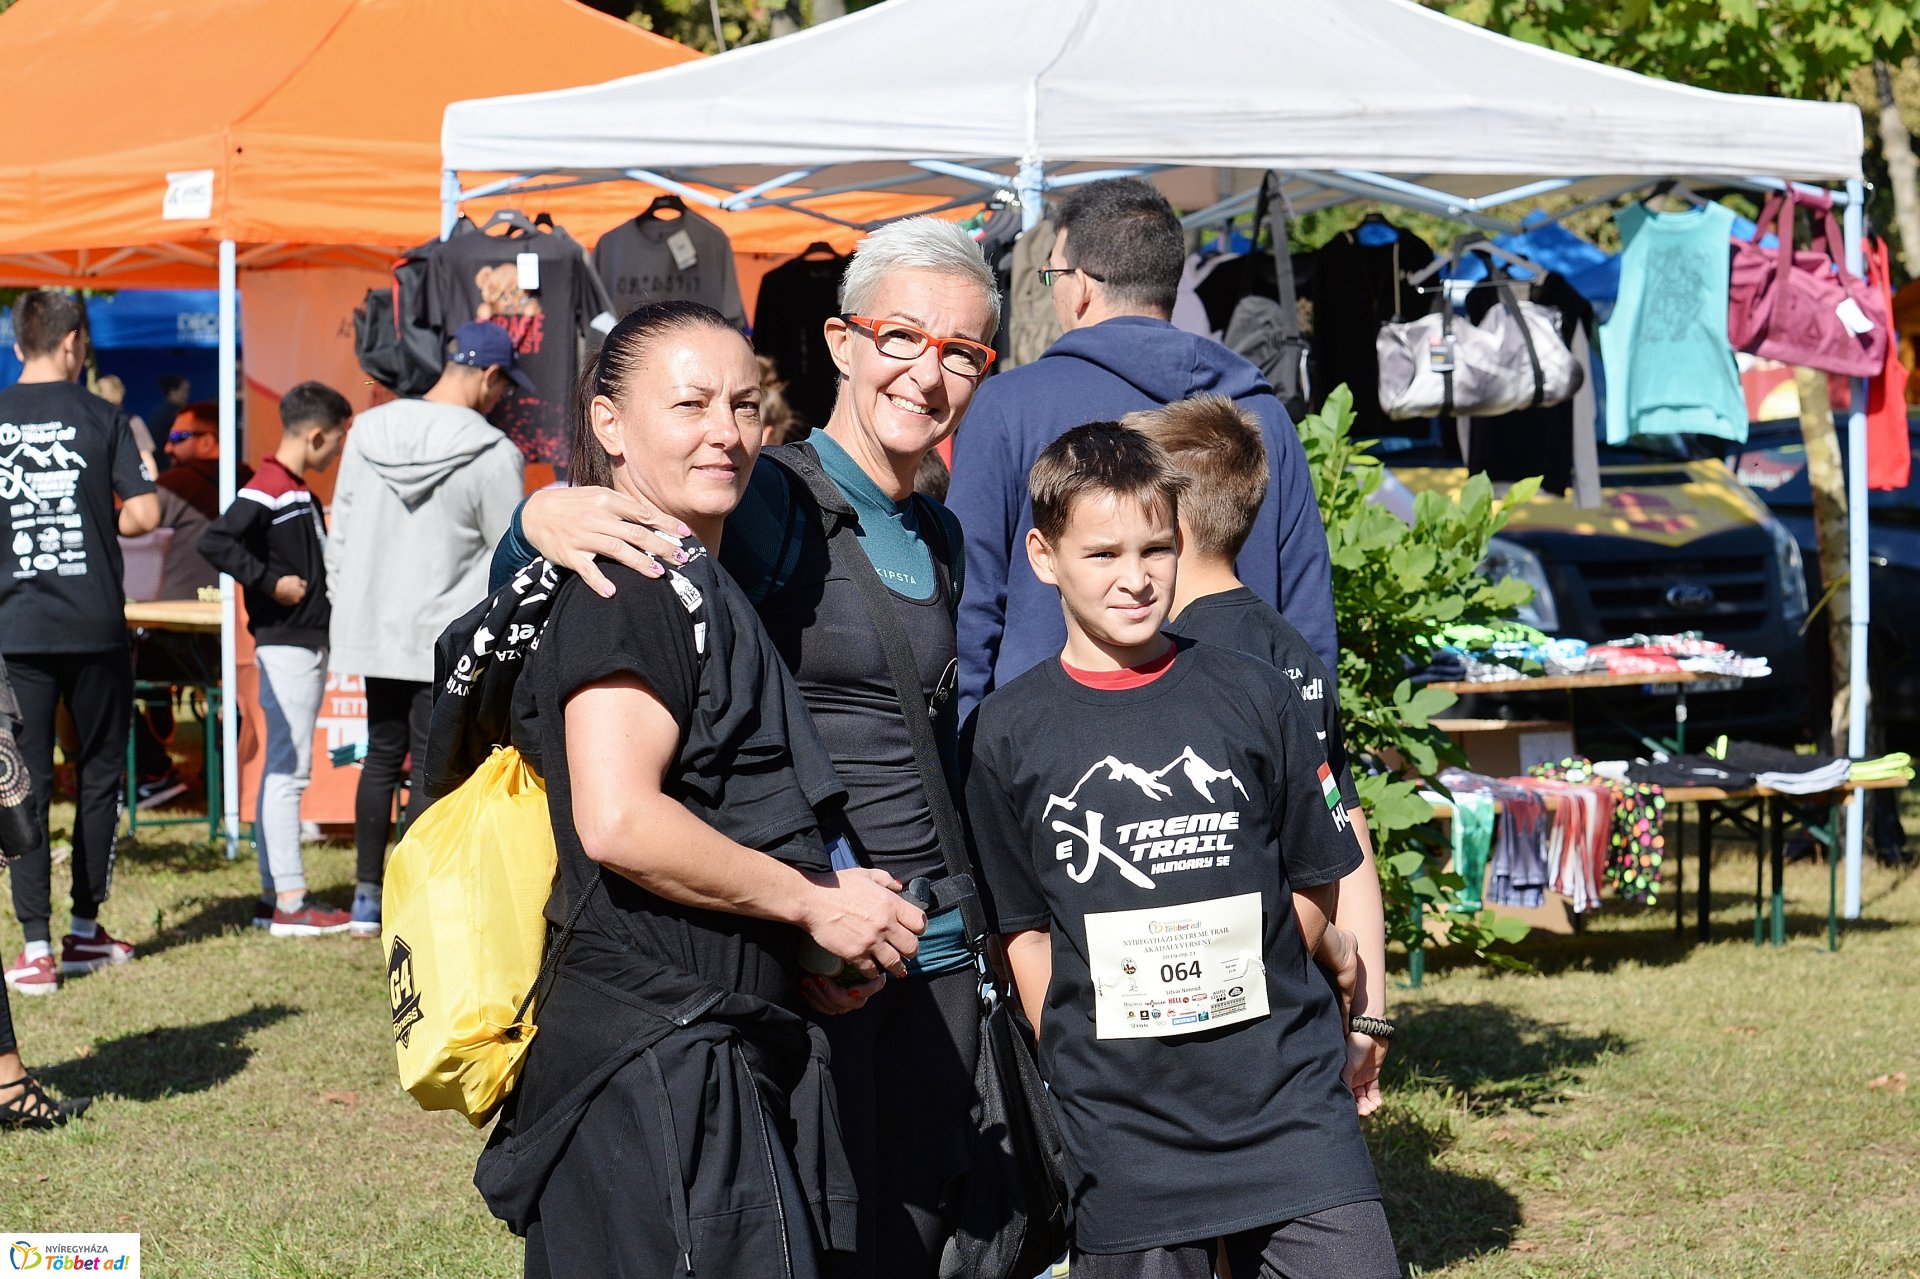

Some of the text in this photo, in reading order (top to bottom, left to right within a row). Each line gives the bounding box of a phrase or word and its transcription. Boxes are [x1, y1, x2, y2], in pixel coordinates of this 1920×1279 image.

[875, 567, 917, 585] KIPSTA
[1129, 834, 1234, 863] TRAIL
[1151, 855, 1231, 876] HUNGARY SE
[1174, 930, 1209, 941] EXTREME
[1210, 926, 1230, 936] TRAIL
[1160, 960, 1202, 983] 064
[390, 957, 413, 1011] G4
